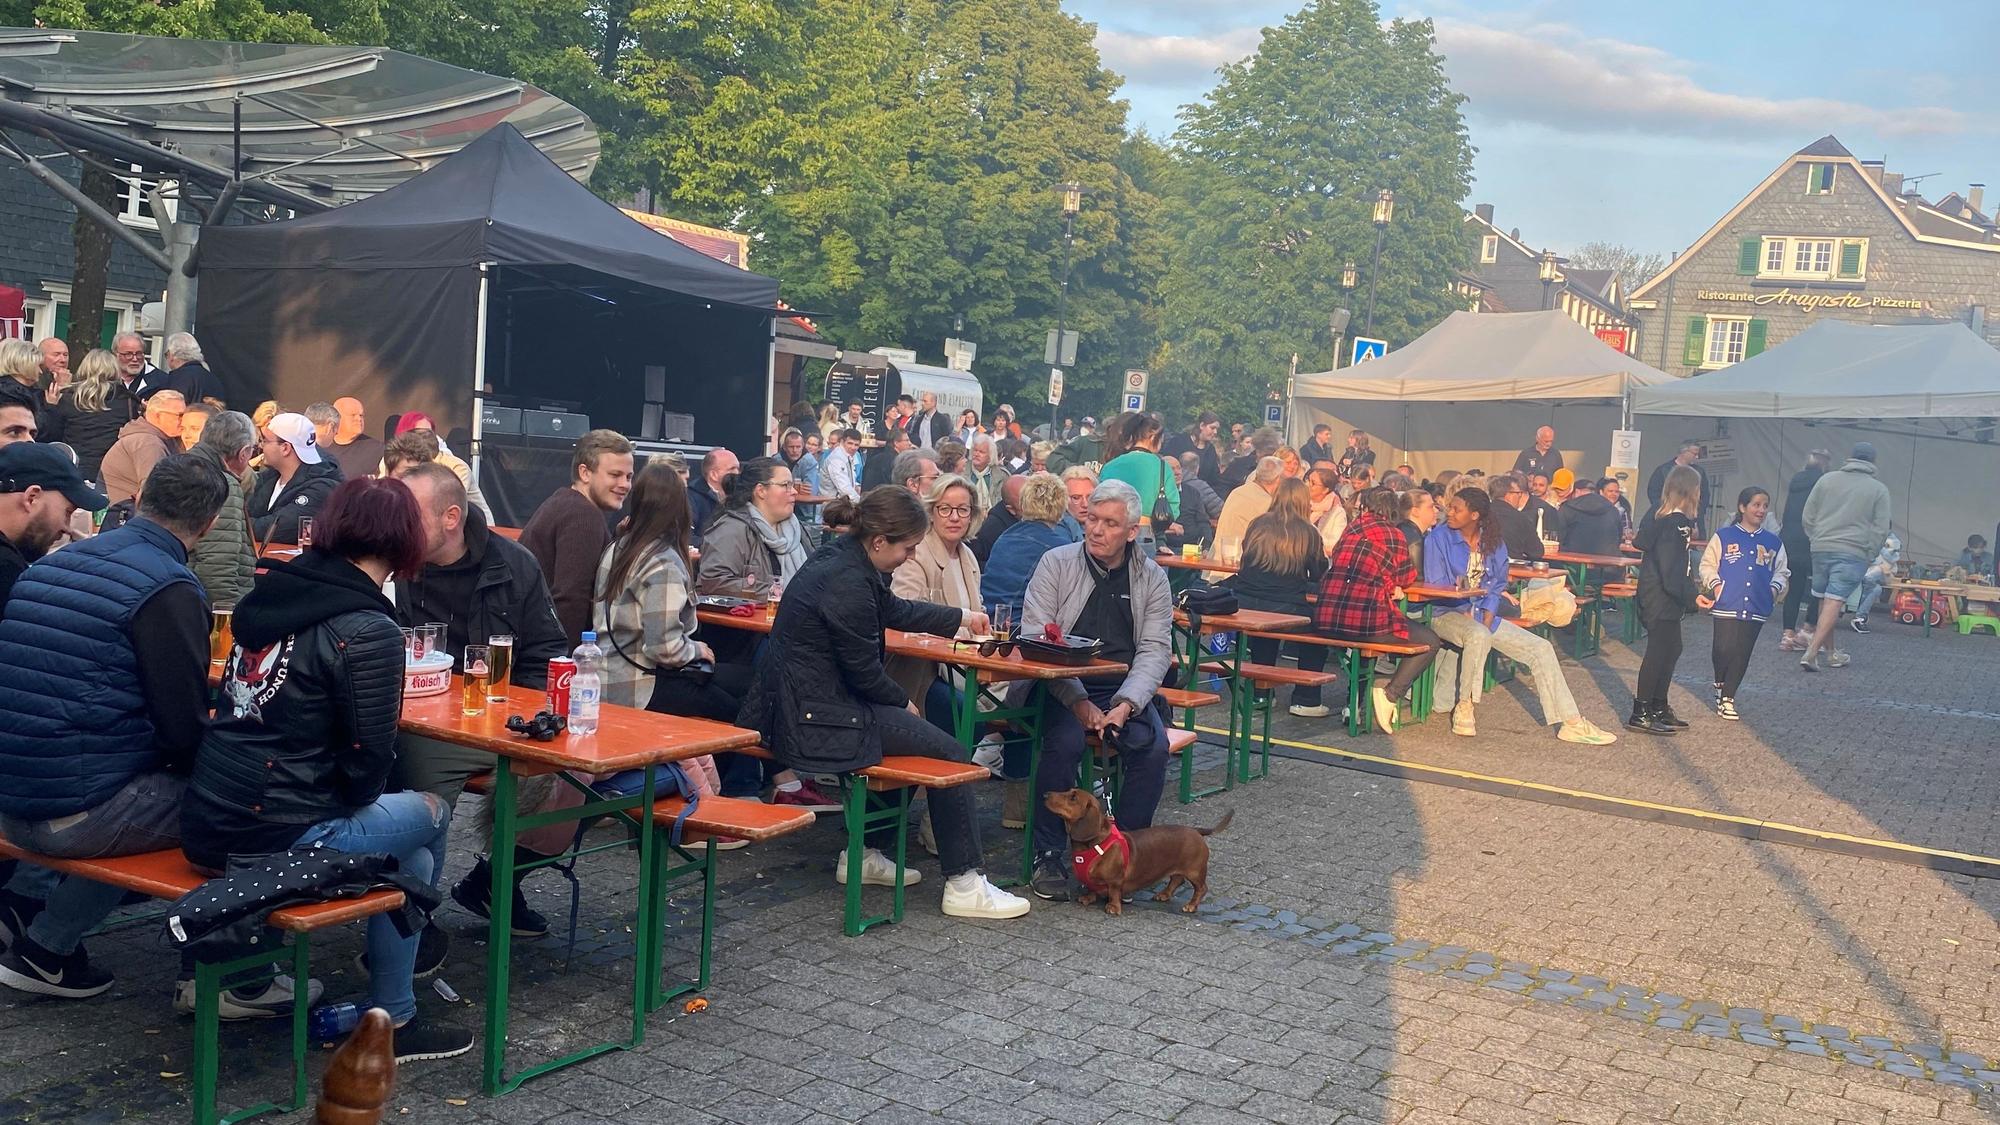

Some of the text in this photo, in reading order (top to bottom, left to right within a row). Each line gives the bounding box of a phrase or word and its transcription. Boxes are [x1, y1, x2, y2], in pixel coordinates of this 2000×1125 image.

[1697, 288, 1922, 312] Ristorante Aragosta Pizzeria
[1755, 544, 1777, 572] M
[258, 656, 289, 706] PUNCH
